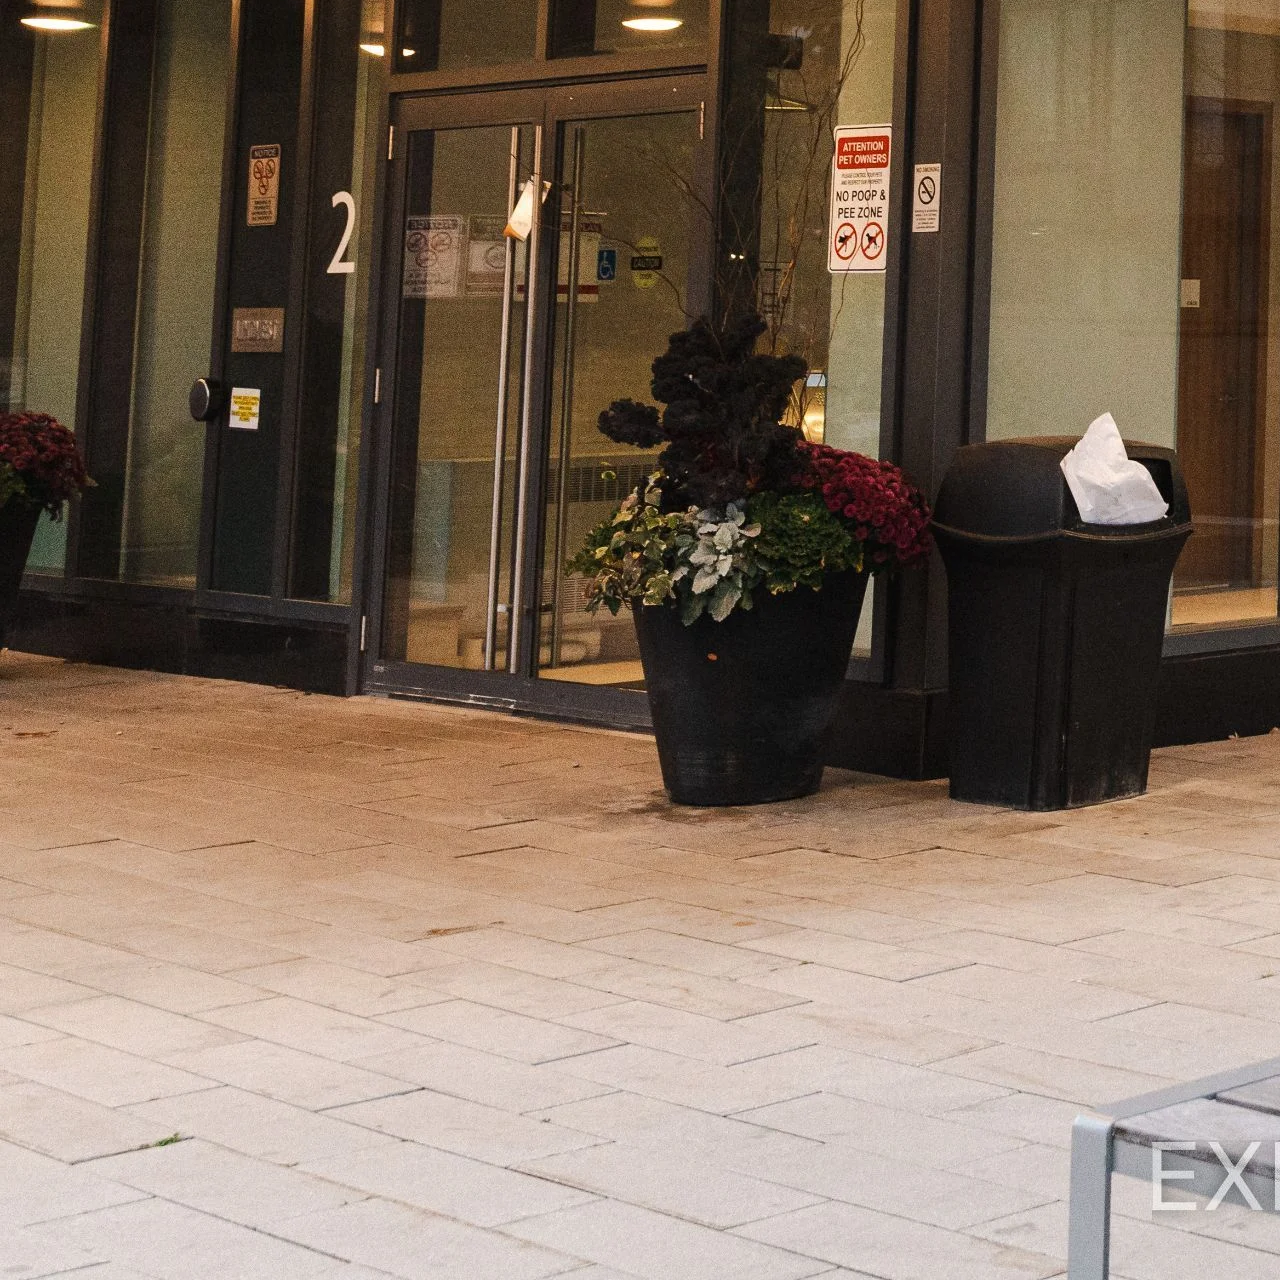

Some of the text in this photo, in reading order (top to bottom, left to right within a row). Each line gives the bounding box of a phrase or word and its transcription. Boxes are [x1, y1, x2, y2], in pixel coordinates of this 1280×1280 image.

[843, 141, 884, 152] ATTENTION
[838, 153, 887, 165] PET OWNERS
[836, 189, 886, 202] NO POOP &
[838, 206, 883, 219] PEE ZONE
[326, 191, 356, 274] 2
